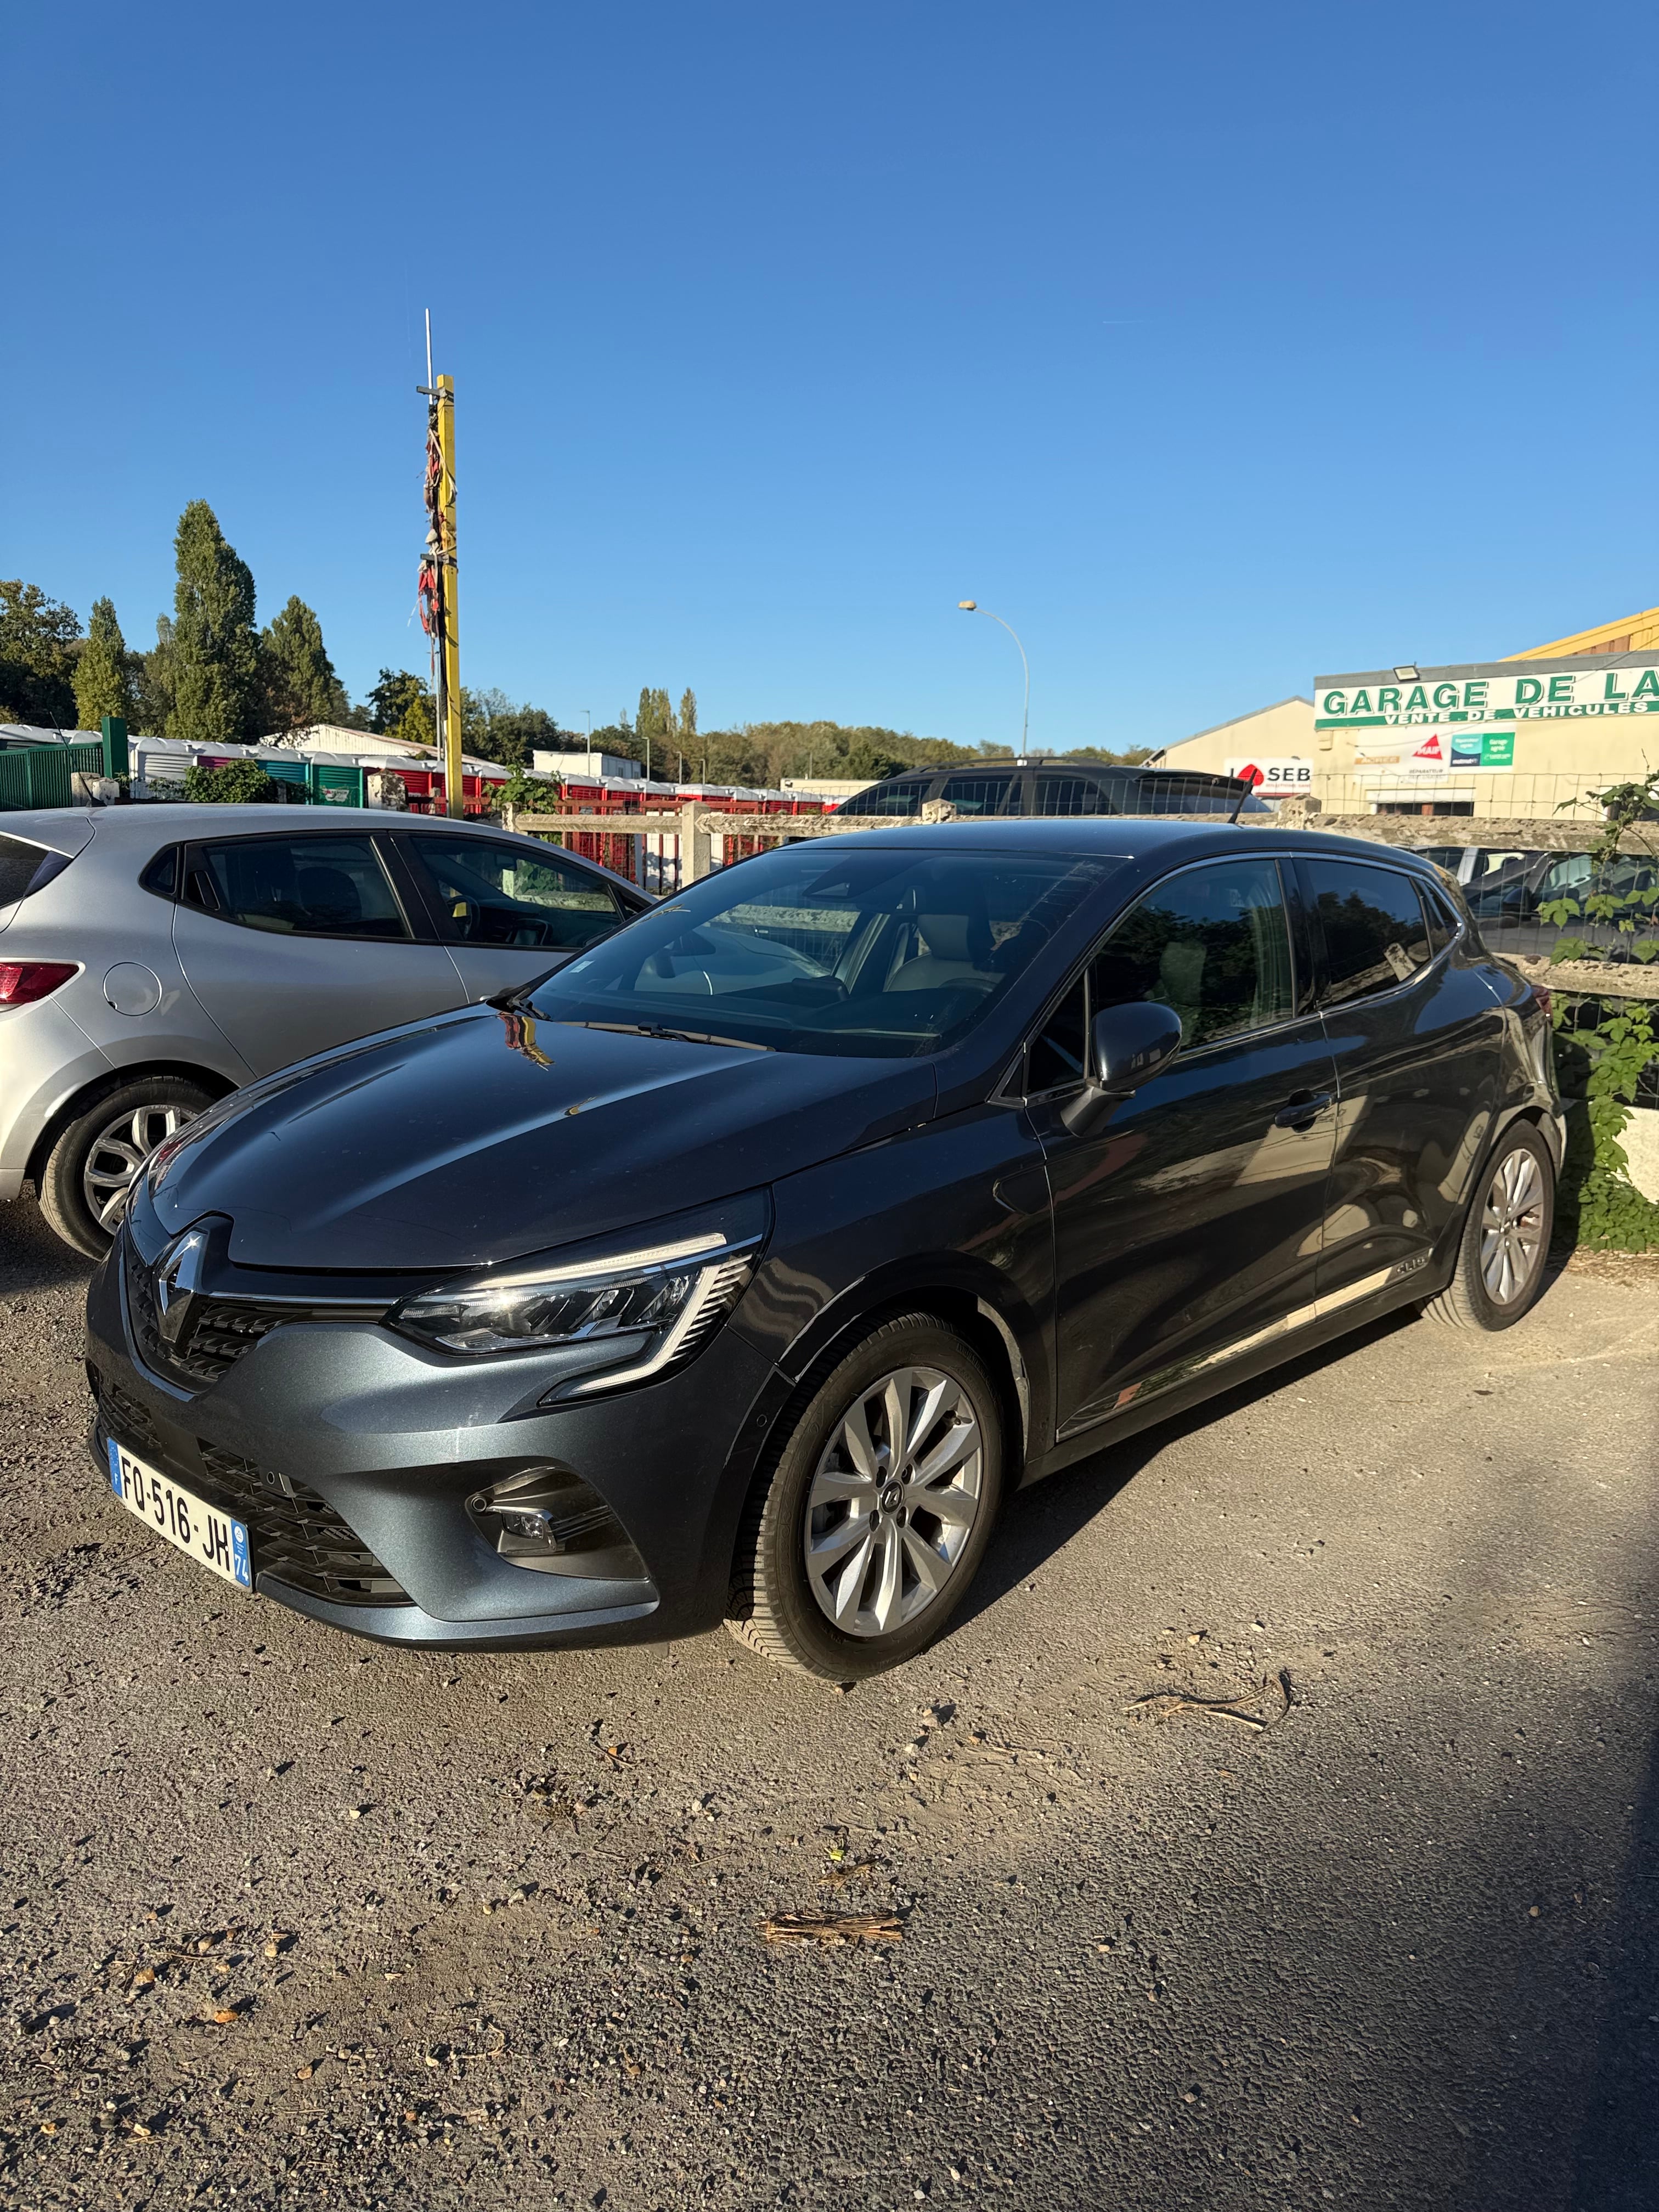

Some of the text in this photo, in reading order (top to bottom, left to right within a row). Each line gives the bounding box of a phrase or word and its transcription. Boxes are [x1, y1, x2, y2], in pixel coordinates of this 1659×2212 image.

[1323, 670, 1659, 715] GARAGE DE LA
[1384, 702, 1648, 725] VENTE DE VEHICULES
[1267, 768, 1310, 781] SEB
[1397, 1256, 1425, 1274] CLIO
[234, 1553, 249, 1582] 74
